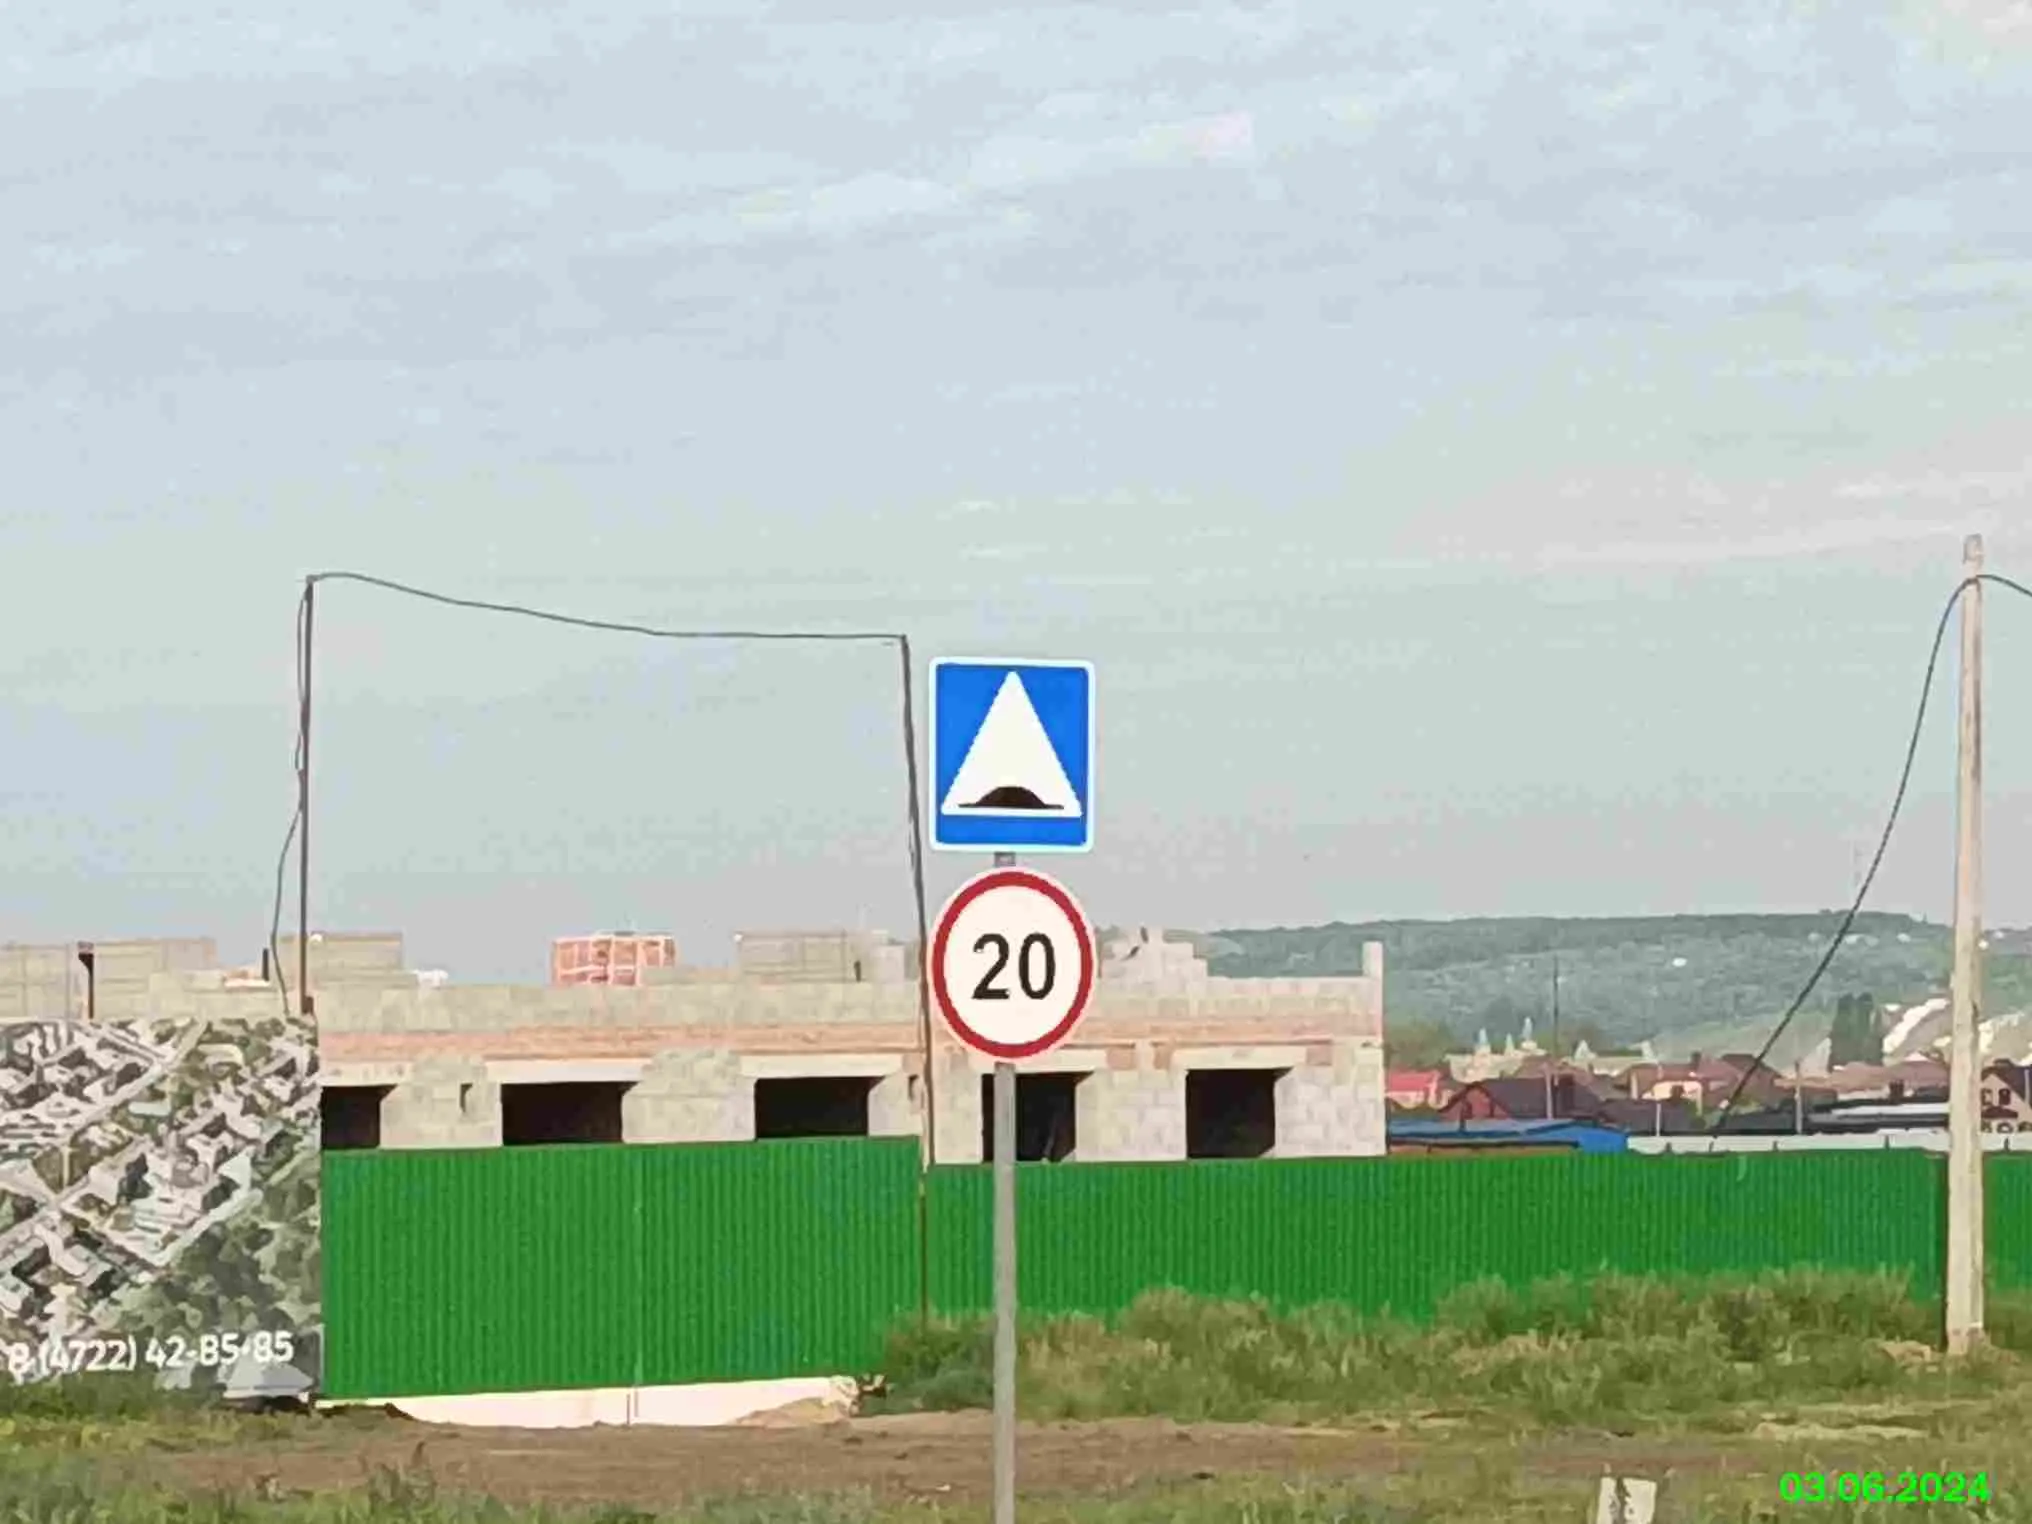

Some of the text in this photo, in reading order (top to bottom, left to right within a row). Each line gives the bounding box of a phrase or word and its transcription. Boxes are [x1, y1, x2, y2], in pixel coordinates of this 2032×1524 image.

[972, 933, 1056, 1000] 20
[8, 1330, 294, 1375] 8 (4722) 42-85-85
